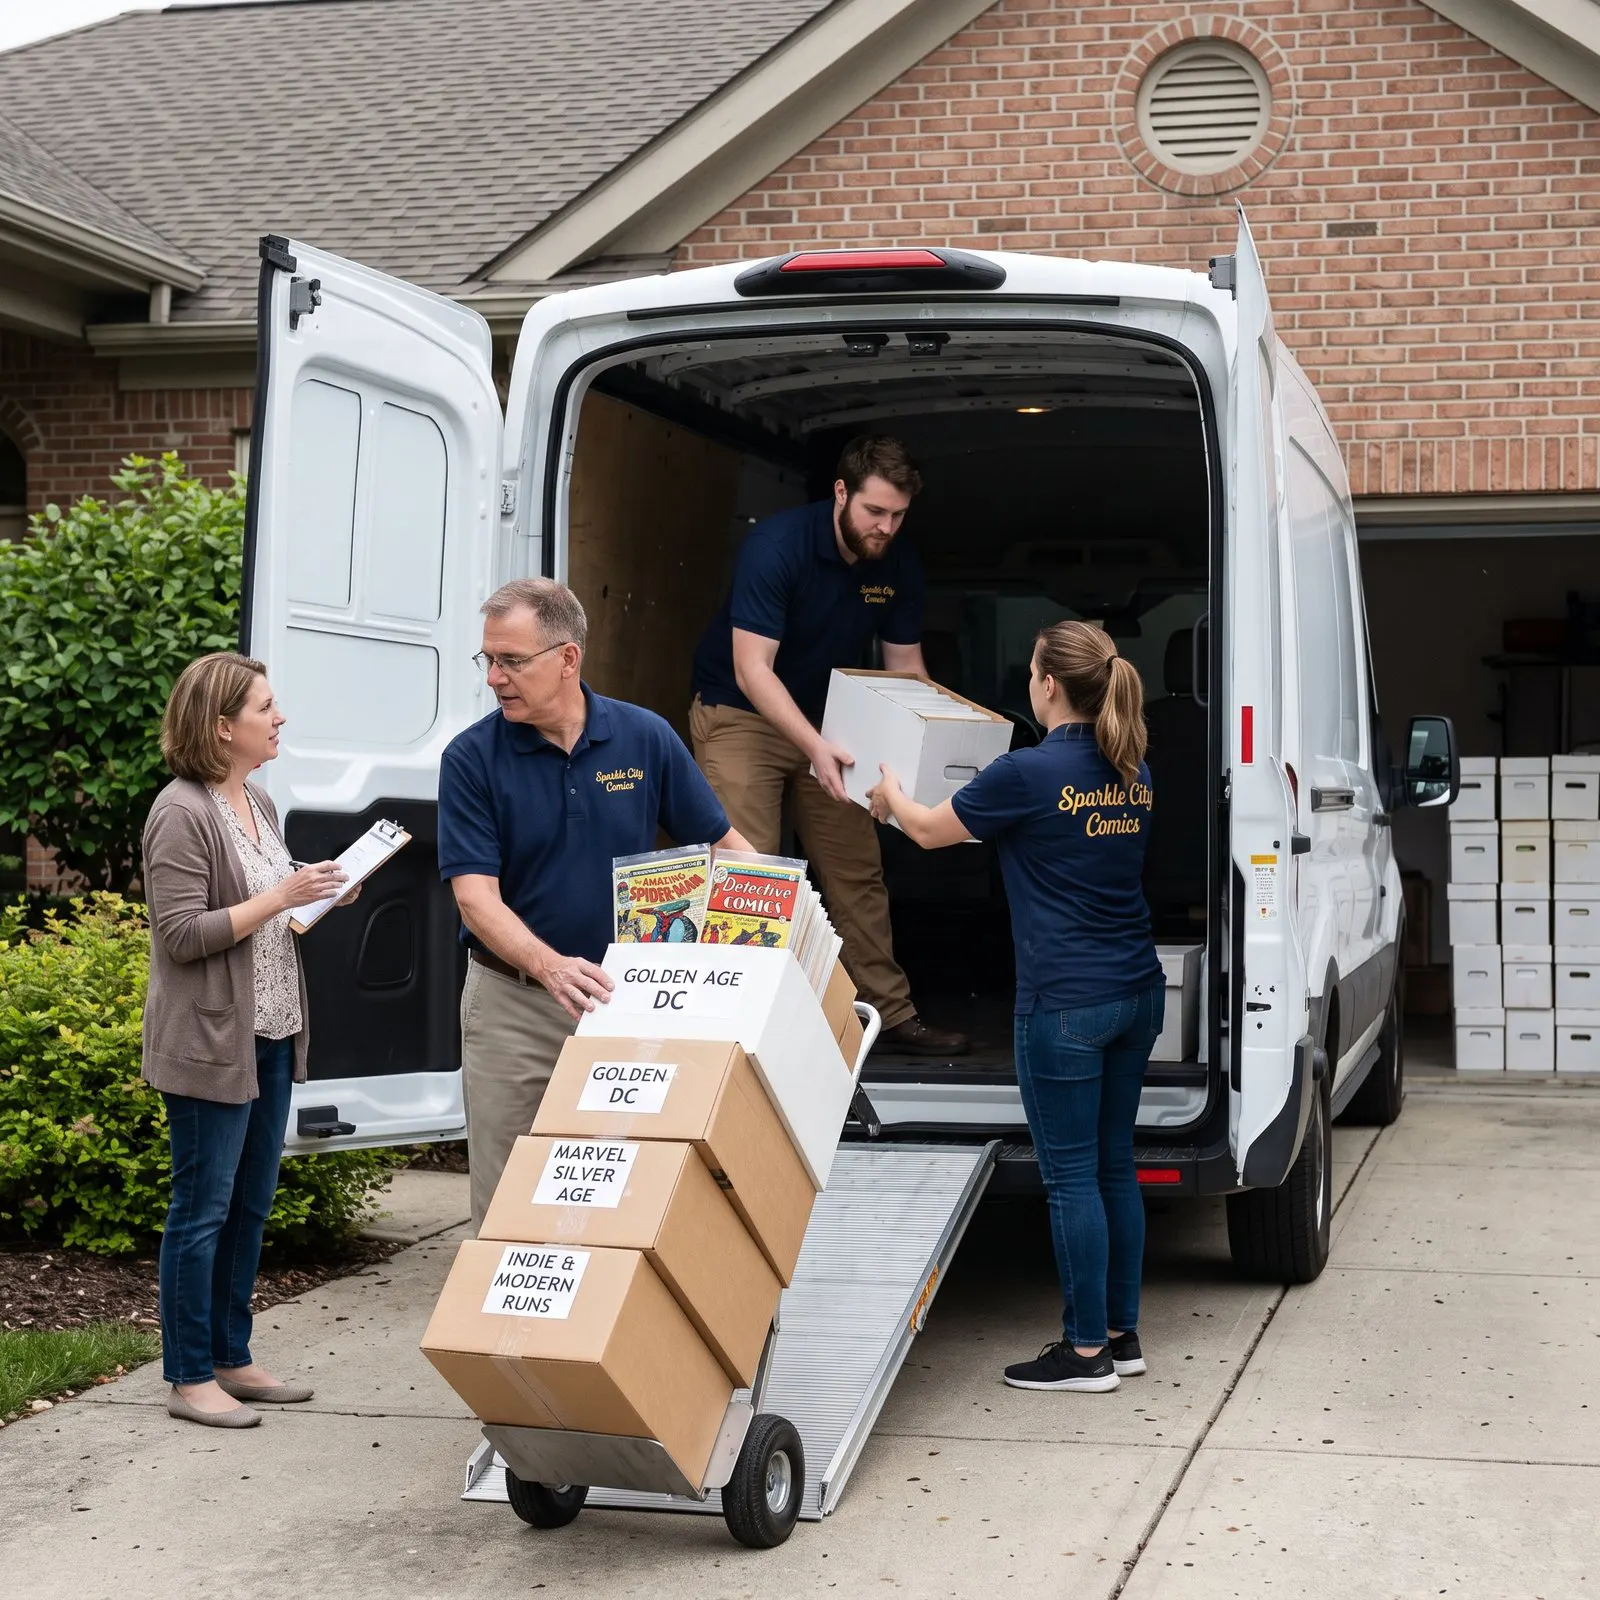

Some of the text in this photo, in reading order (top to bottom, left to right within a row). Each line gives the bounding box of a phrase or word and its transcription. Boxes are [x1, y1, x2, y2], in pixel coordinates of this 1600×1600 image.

[596, 767, 644, 784] Sparkle City
[606, 781, 635, 792] Comics
[1058, 782, 1153, 815] Sparkle City
[1086, 812, 1140, 837] Comics
[642, 873, 686, 887] AMAZING
[722, 876, 792, 899] Detective
[723, 896, 782, 914] COMICS
[623, 968, 743, 987] GOLDEN AGE
[652, 990, 688, 1011] DC
[592, 1066, 667, 1082] GOLDEN
[609, 1087, 639, 1104] DC
[554, 1145, 627, 1162] MARVEL
[553, 1166, 615, 1183] SILVER
[556, 1187, 595, 1203] AGE
[507, 1251, 575, 1271] INDIE &
[494, 1272, 575, 1293] MODERN
[502, 1294, 552, 1313] RUNS
